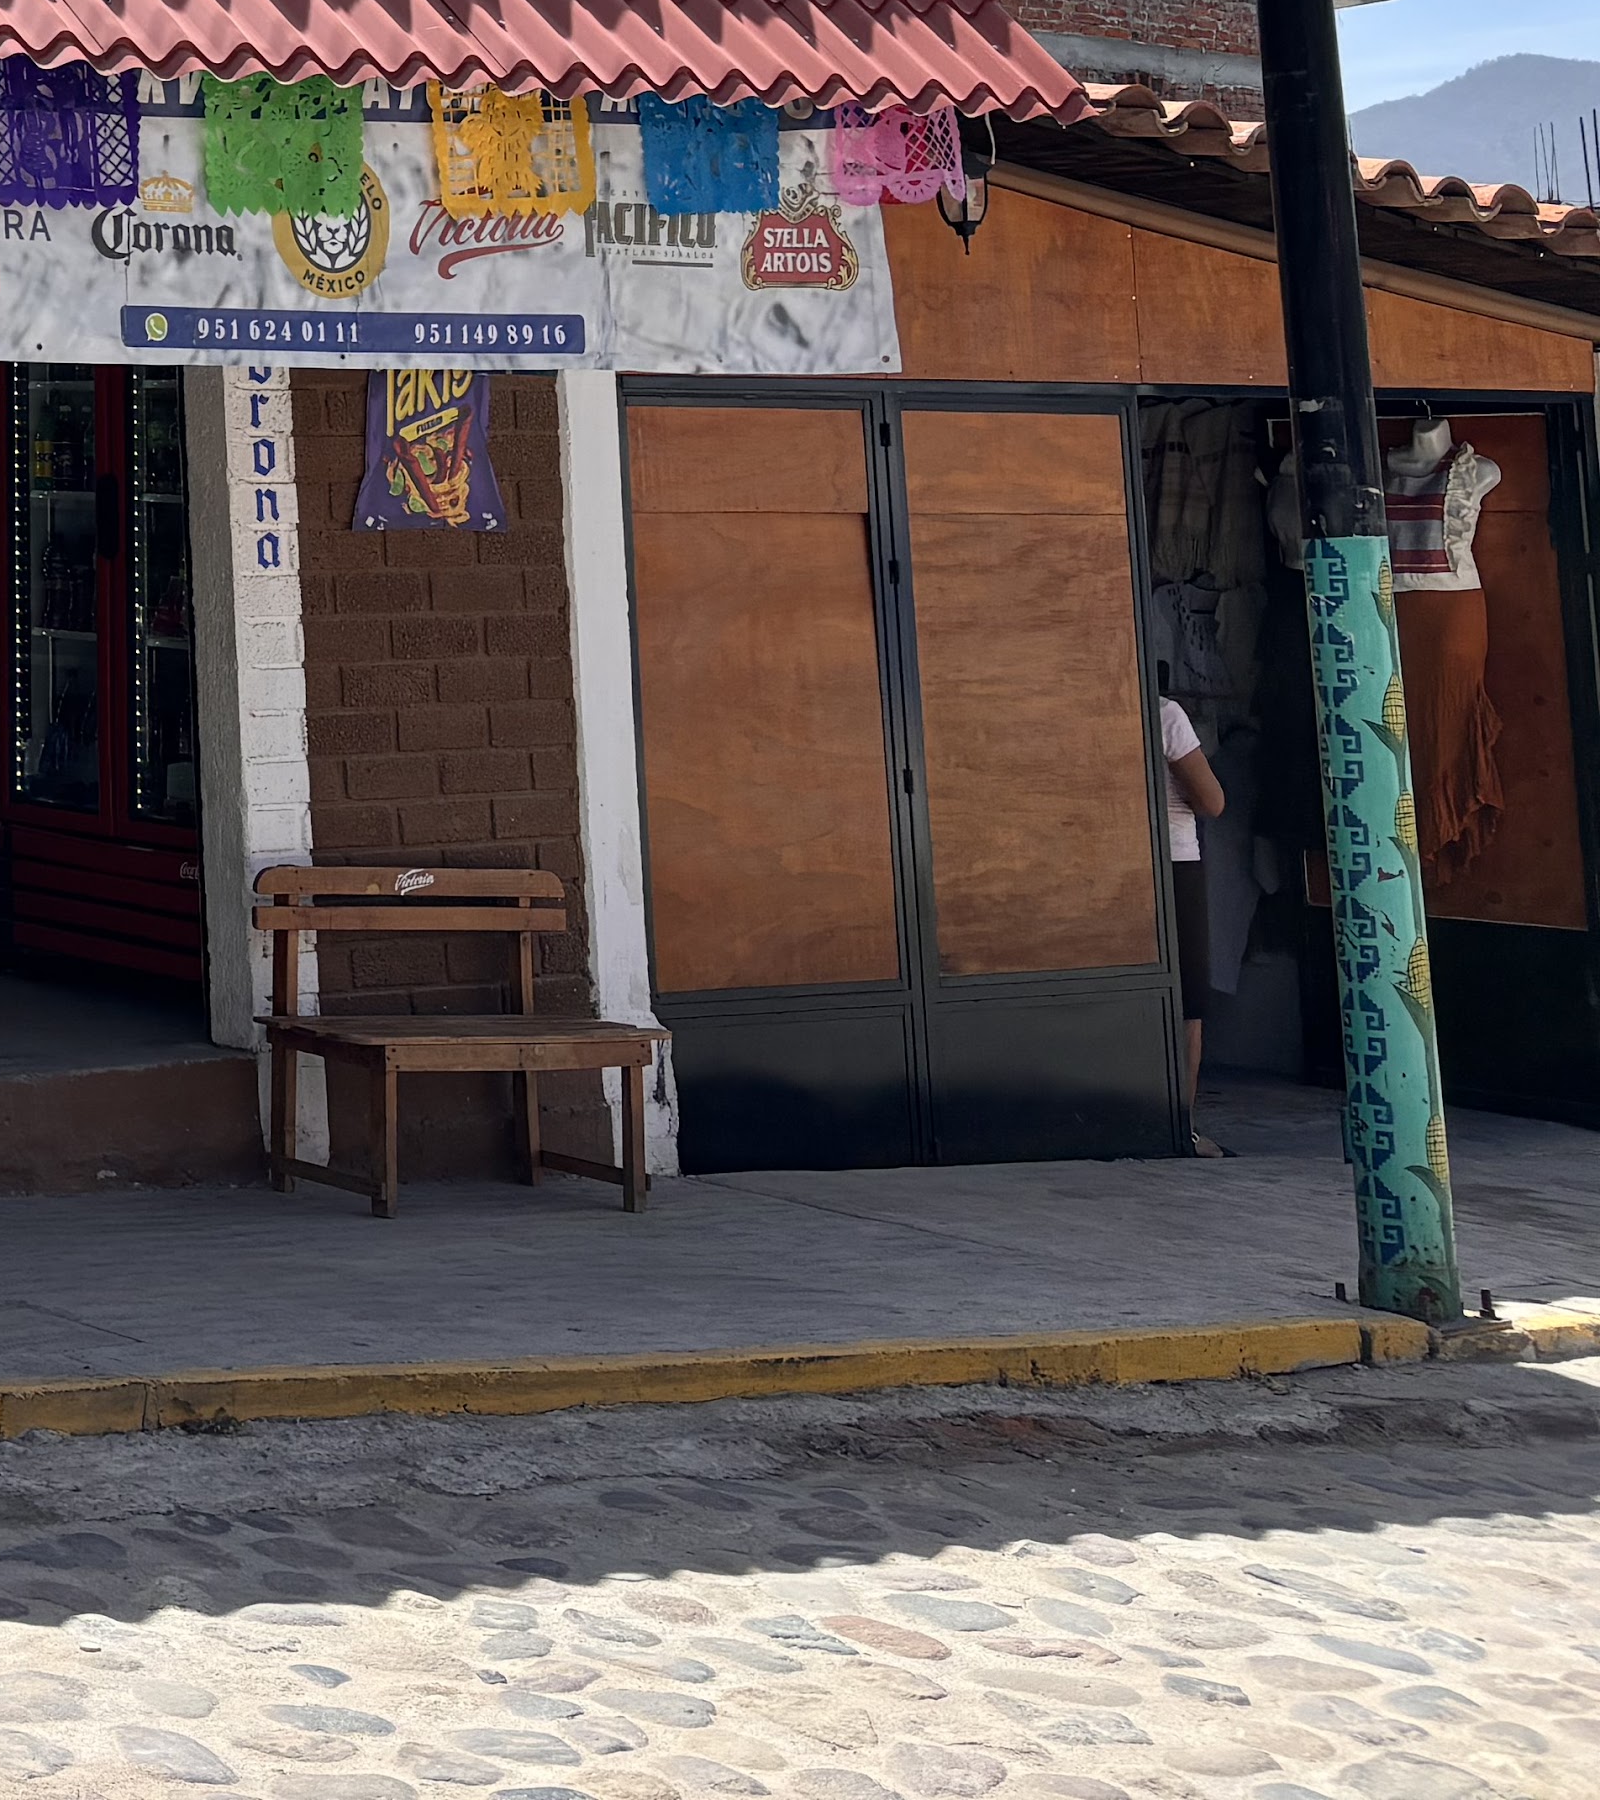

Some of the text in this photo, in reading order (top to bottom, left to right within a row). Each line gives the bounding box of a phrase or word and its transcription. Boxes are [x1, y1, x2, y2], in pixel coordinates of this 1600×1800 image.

[91, 205, 238, 266] Corona
[763, 228, 830, 249] STELLA
[760, 252, 832, 274] ARTOIS
[302, 266, 366, 294] MÉXICO
[197, 317, 567, 347] 951 624 01 11 951 149 89 16
[394, 868, 435, 896] Victoria
